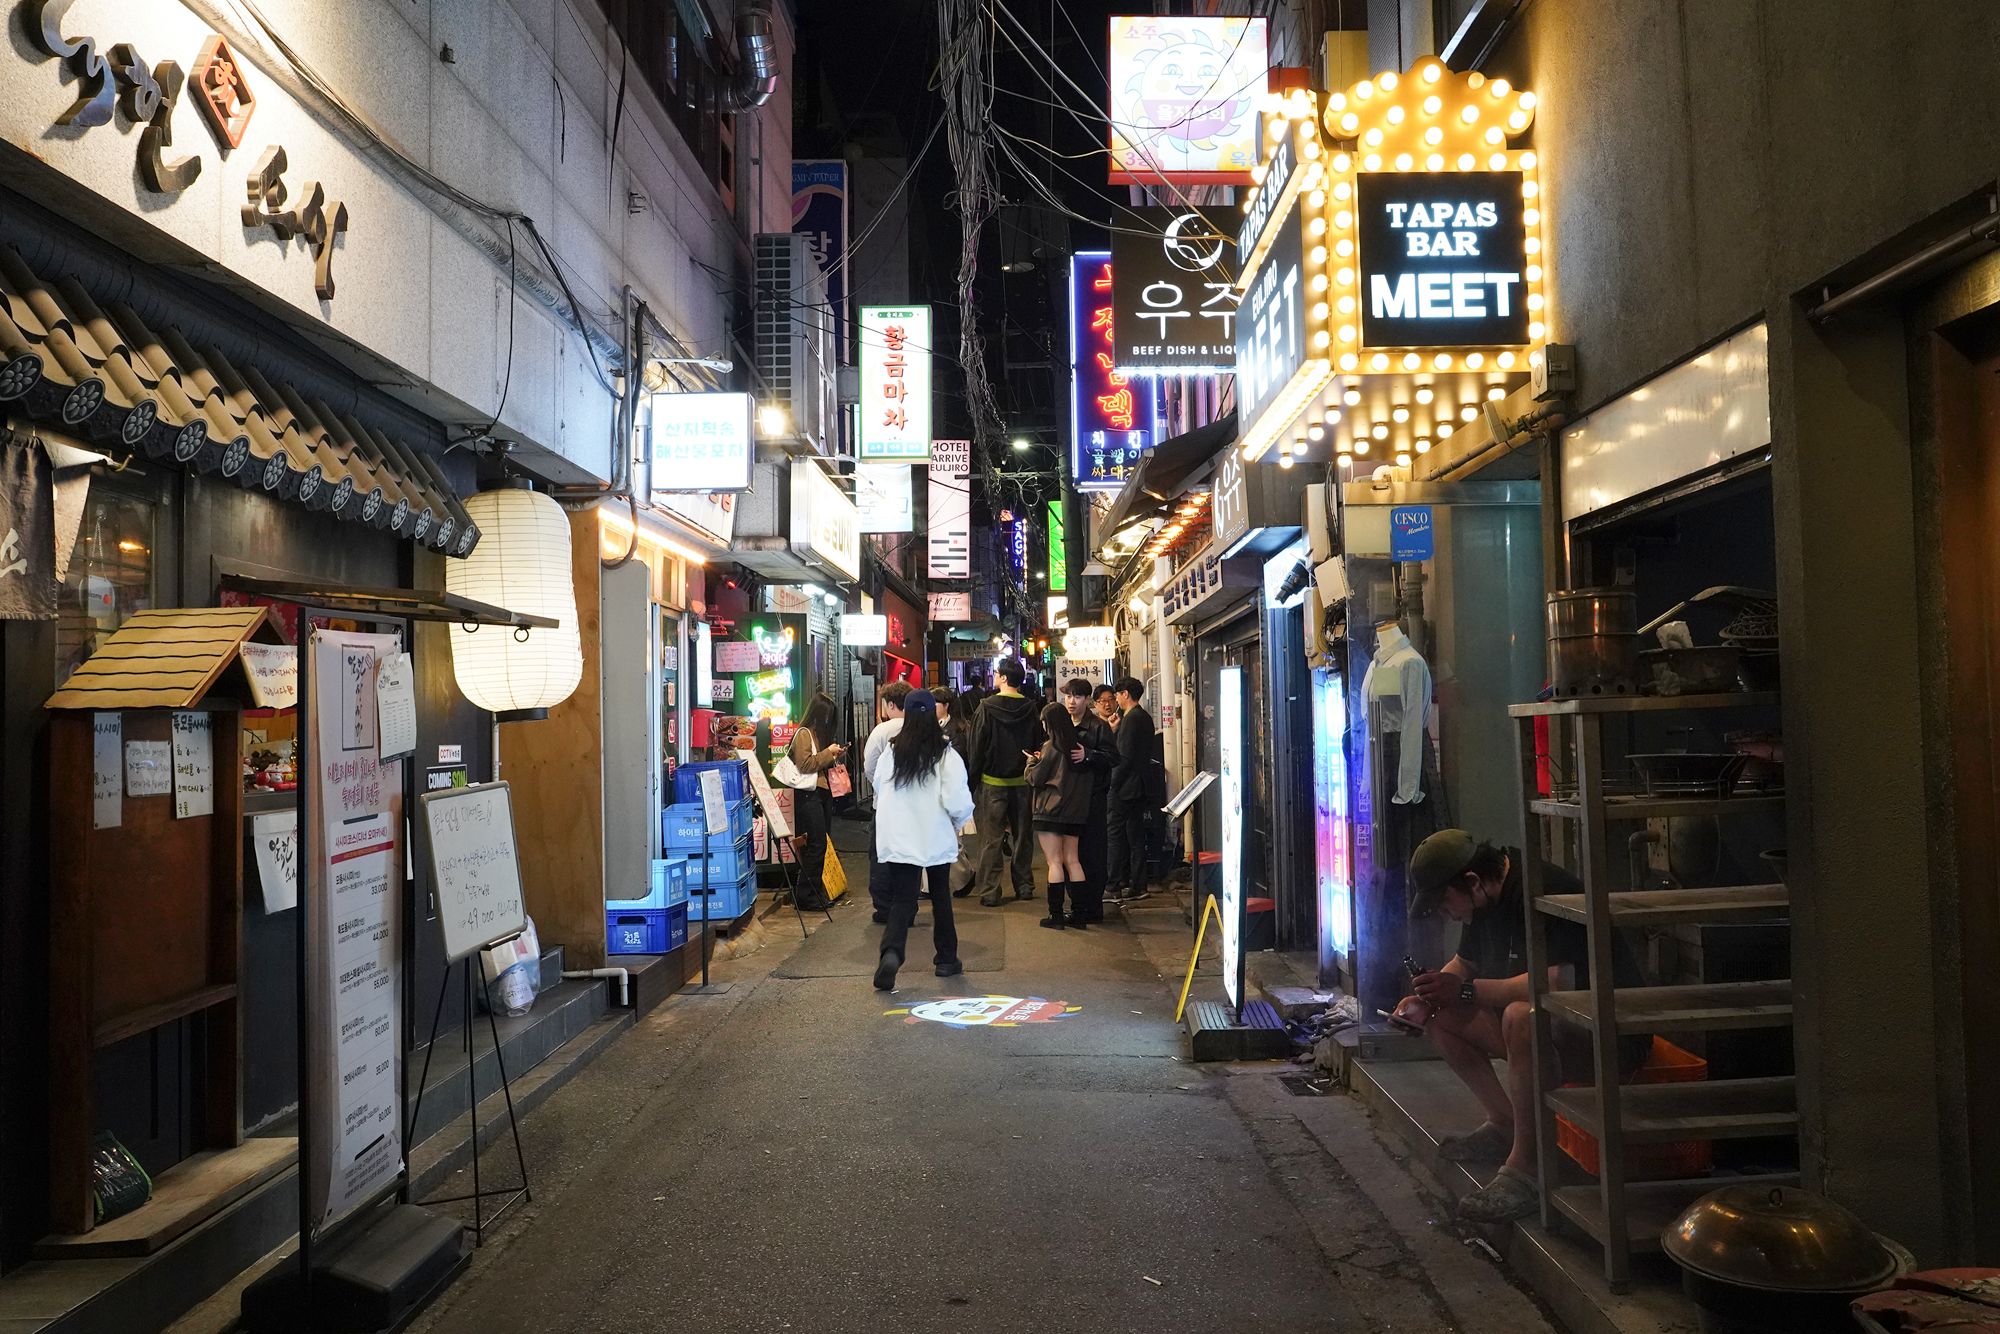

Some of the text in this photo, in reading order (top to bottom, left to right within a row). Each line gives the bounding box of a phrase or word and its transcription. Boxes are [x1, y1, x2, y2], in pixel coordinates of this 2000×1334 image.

[1123, 25, 1157, 40] 소주
[1240, 143, 1289, 263] TAPAS BAR
[1385, 201, 1498, 229] TAPAS
[1405, 232, 1481, 257] BAR
[1370, 271, 1520, 319] MEET
[1135, 280, 1238, 341] 우주
[1240, 264, 1298, 421] MEET
[1132, 346, 1162, 355] BEEF
[1167, 346, 1195, 355] DISH
[1200, 346, 1208, 355] &
[883, 325, 909, 431] 황금마차
[665, 421, 735, 437] 산지직송
[932, 442, 968, 452] HOTEL
[932, 453, 968, 463] ARRIVE
[930, 463, 969, 472] EULJIRO
[1395, 511, 1428, 525] CESCO
[1059, 666, 1101, 677] 을지하옥
[428, 771, 451, 790] COMING
[373, 929, 389, 941] 44,000
[373, 975, 390, 990] 55,000
